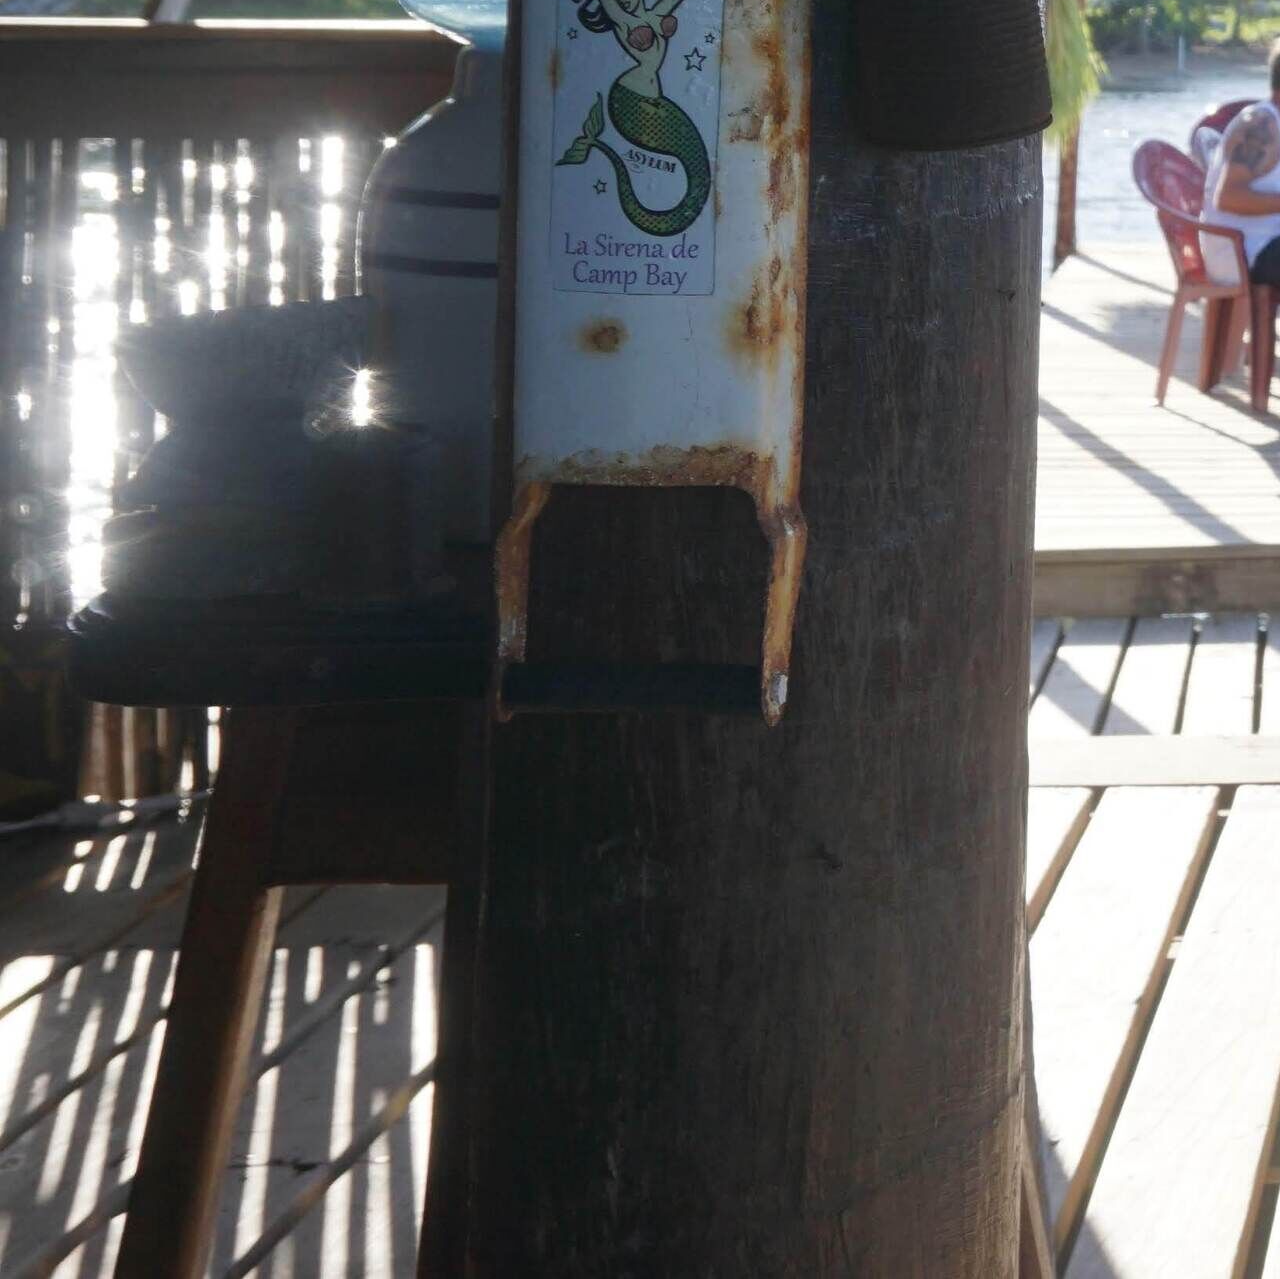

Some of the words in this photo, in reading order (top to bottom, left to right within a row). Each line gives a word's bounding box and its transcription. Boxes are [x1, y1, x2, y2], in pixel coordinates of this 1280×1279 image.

[625, 149, 677, 174] ASYLUM
[564, 233, 589, 258] La
[594, 233, 665, 259] Sirena
[671, 233, 699, 260] de
[572, 261, 638, 292] Camp
[644, 263, 688, 294] Bay
